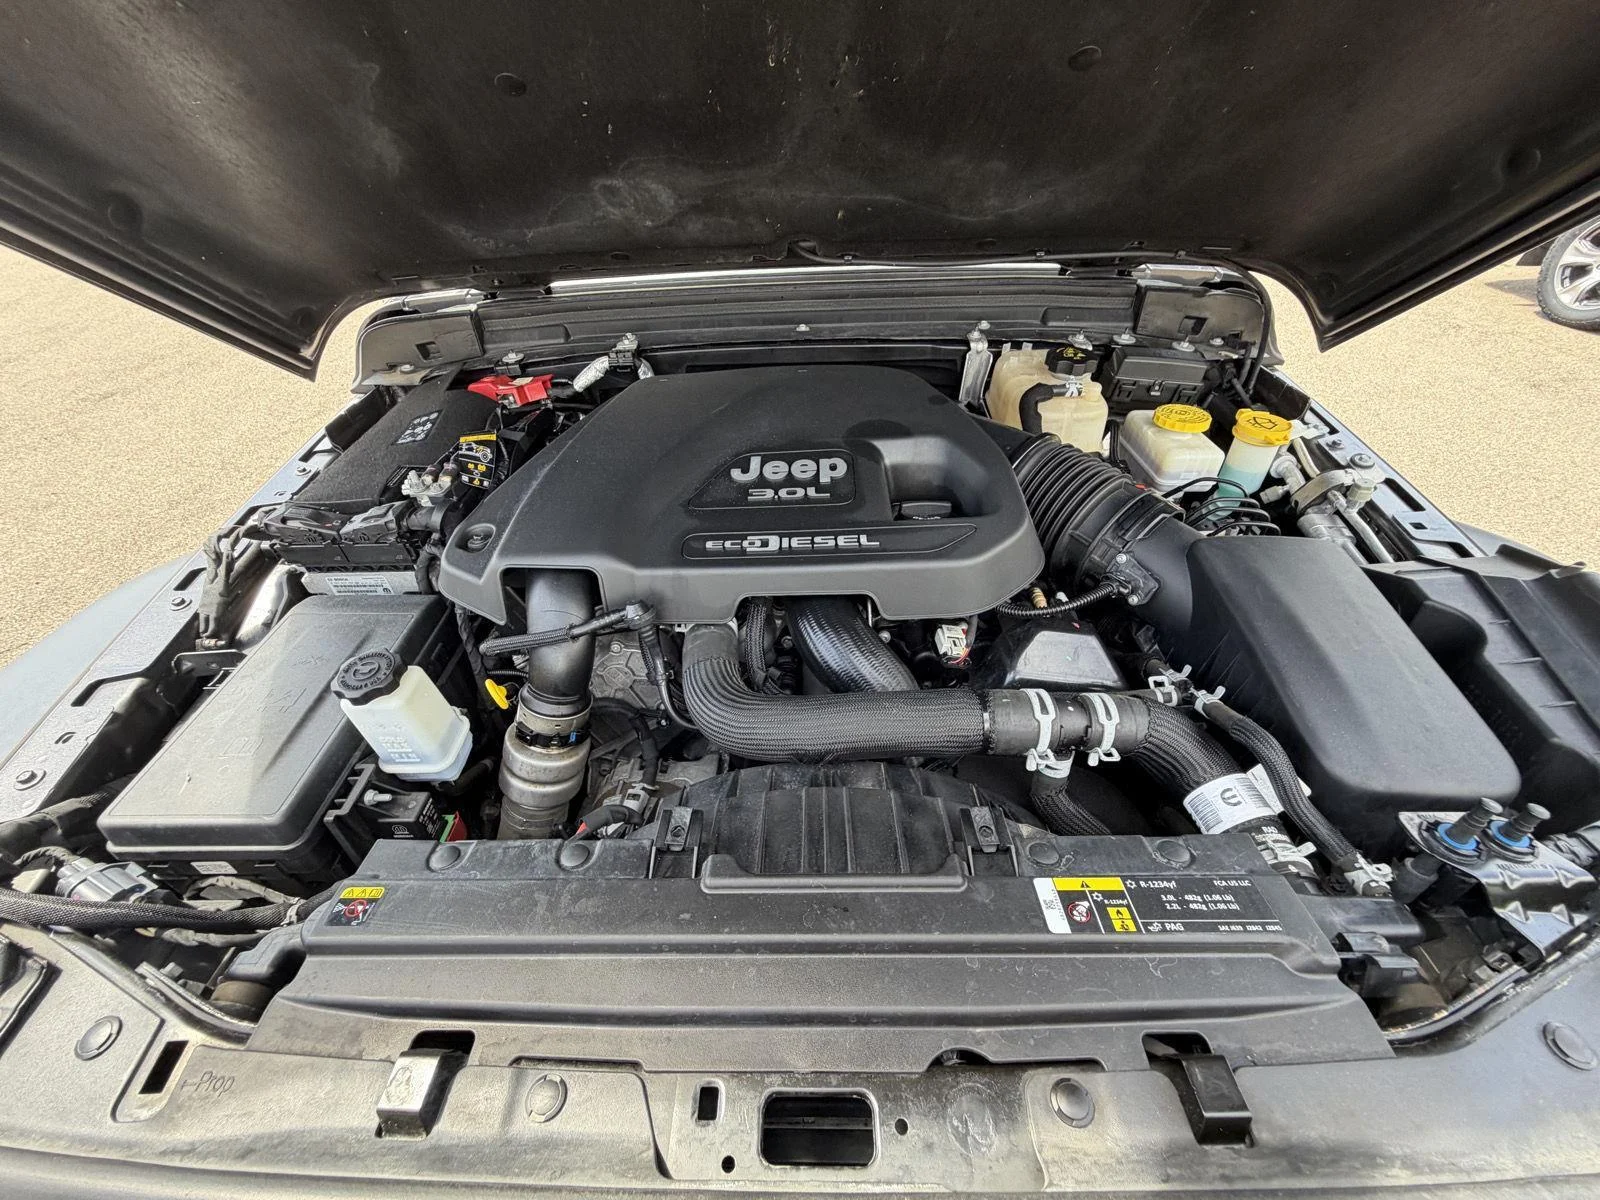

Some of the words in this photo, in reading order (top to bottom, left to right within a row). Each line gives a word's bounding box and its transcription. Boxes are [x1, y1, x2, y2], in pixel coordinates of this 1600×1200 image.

[730, 456, 847, 484] Jeep
[748, 487, 830, 501] 3.0L
[706, 535, 880, 552] ECODIESEL
[1139, 880, 1177, 889] R-1234yf
[1165, 923, 1184, 931] PAG
[195, 1070, 235, 1097] Prop
